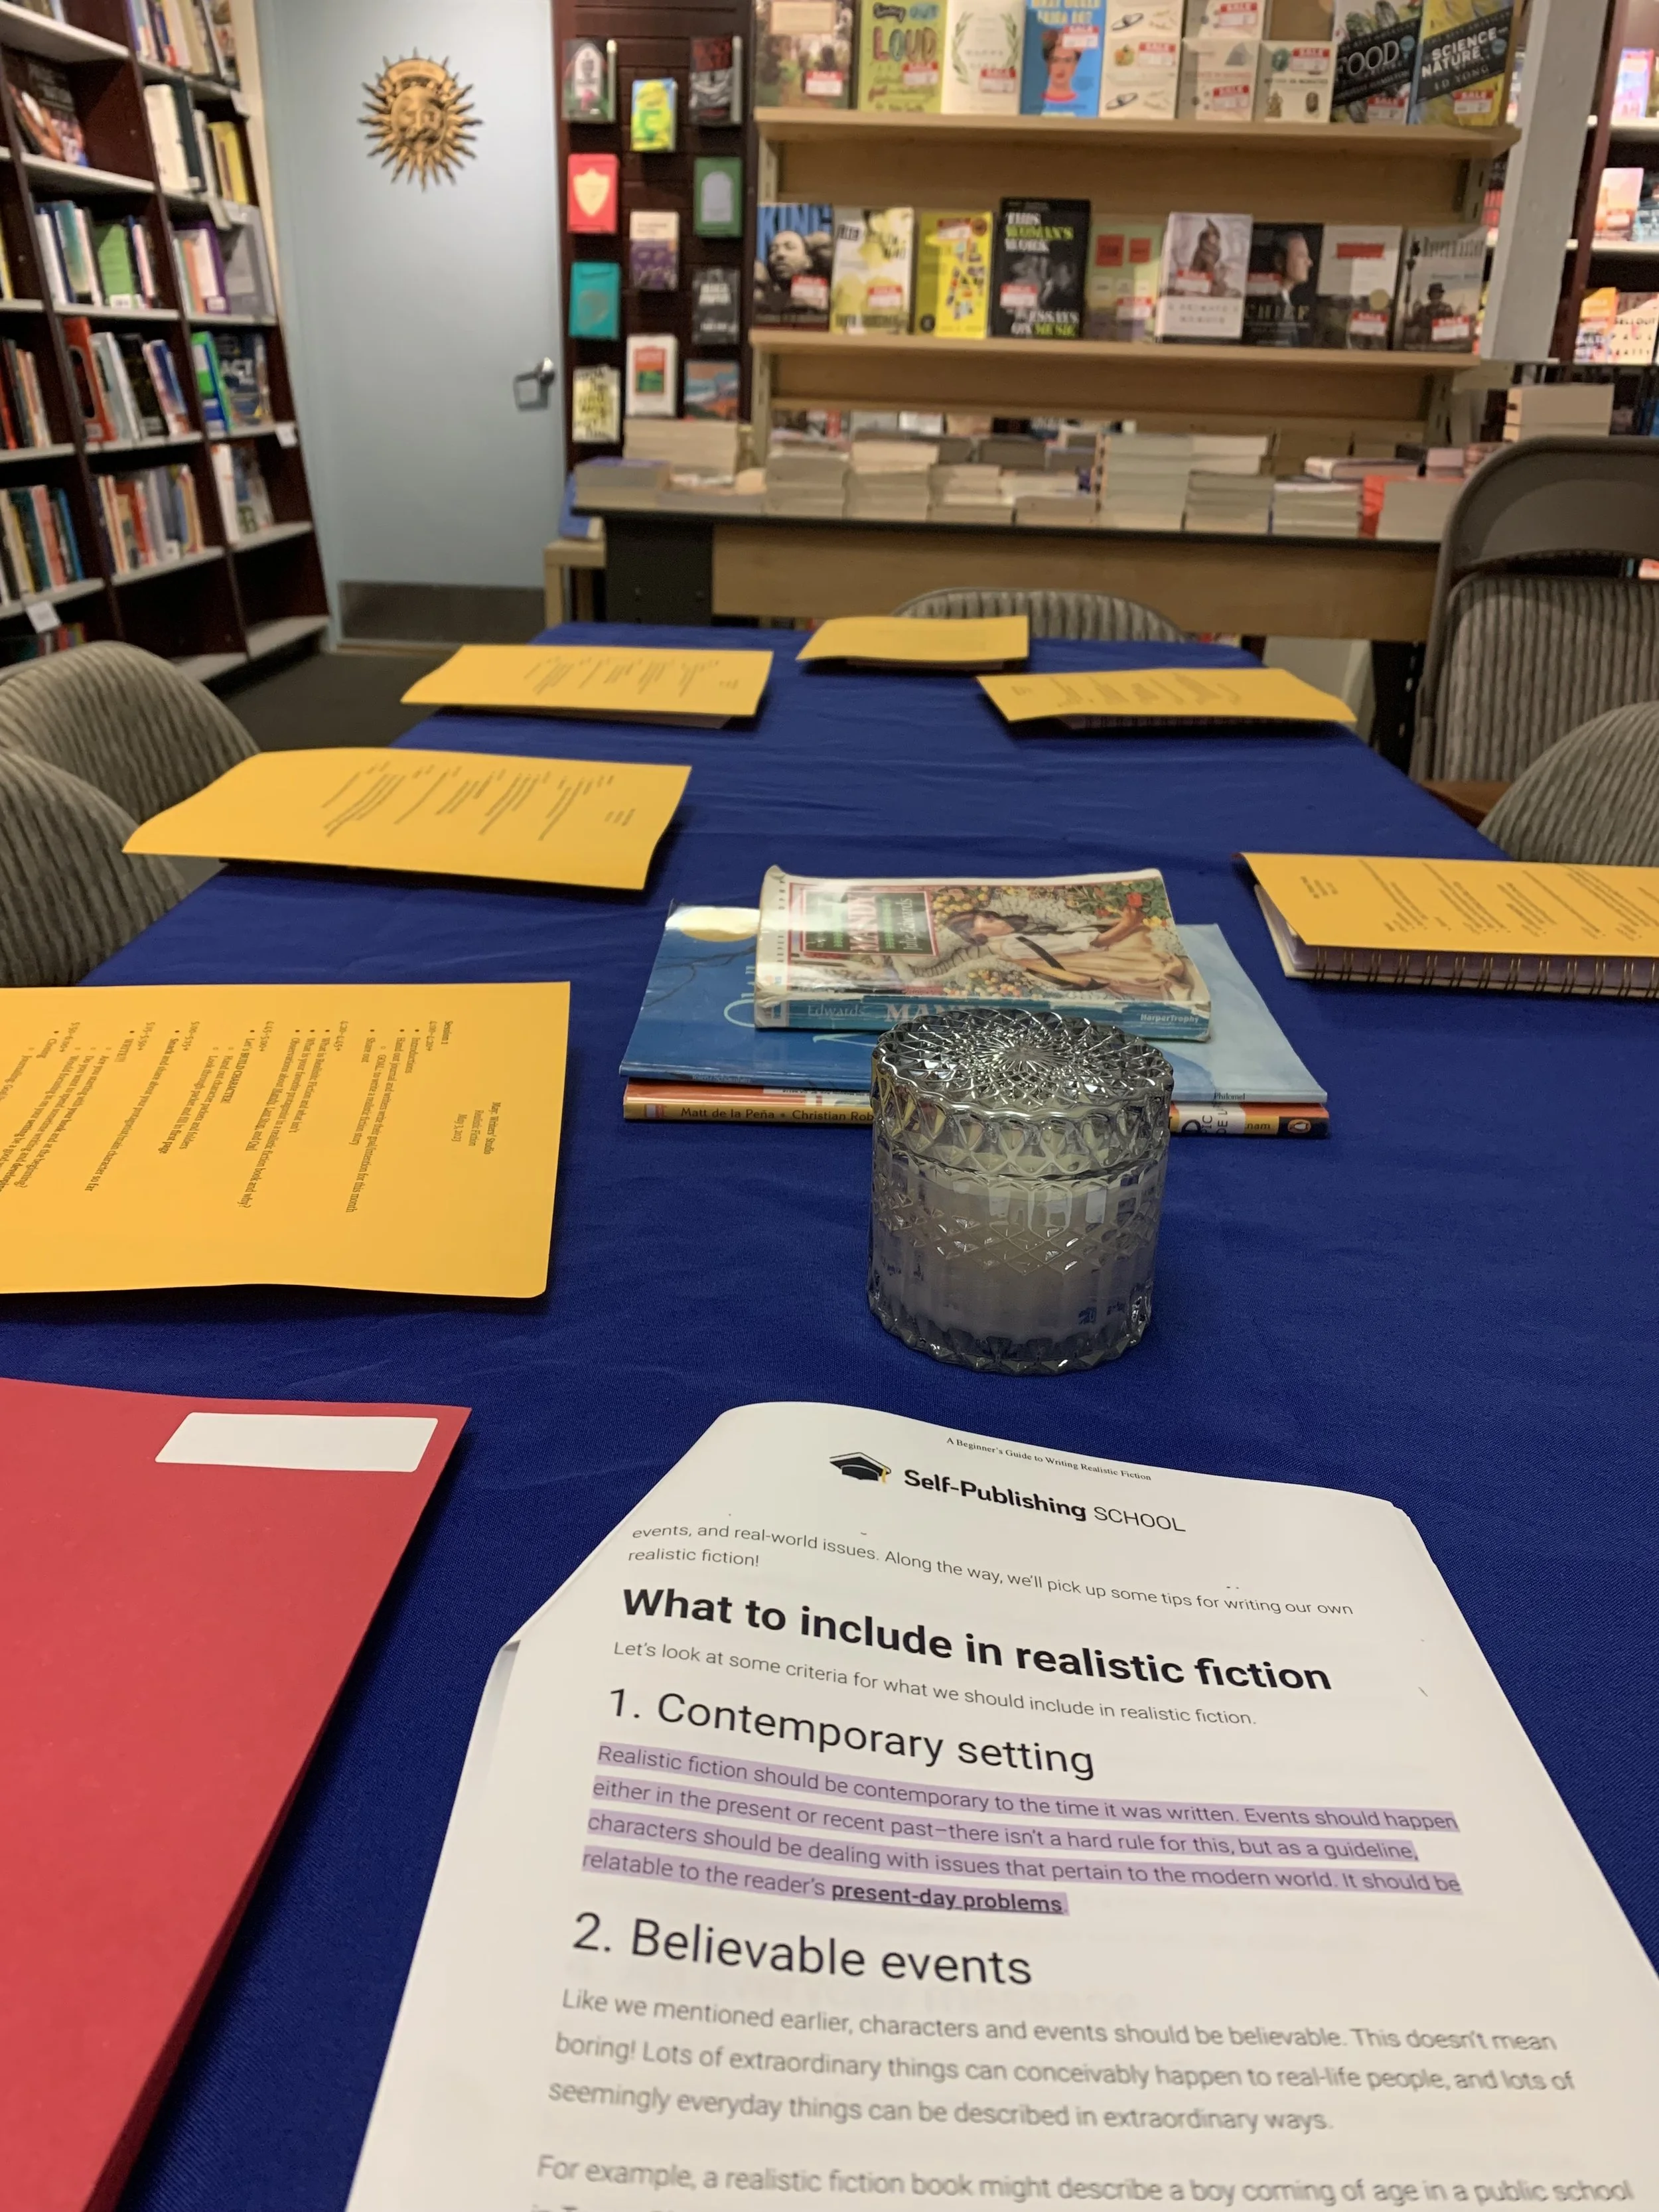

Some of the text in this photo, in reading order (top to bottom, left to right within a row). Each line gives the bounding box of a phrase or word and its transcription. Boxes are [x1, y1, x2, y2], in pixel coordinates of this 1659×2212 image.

[873, 27, 937, 63] LOUD
[1422, 45, 1481, 78] NATURE
[1432, 27, 1497, 61] SCIENCE
[900, 934, 923, 951] Julie
[808, 1003, 863, 1017] Edwards
[1140, 1013, 1199, 1023] HarperTrophy
[681, 1107, 707, 1118] Matt
[714, 1108, 726, 1118] de
[731, 1108, 741, 1119] la
[746, 1108, 775, 1120] Peña
[792, 1109, 846, 1121] Christian
[484, 1138, 495, 1155] Studio
[956, 1439, 1003, 1454] Beginner's
[1005, 1449, 1032, 1460] Guide
[1045, 1457, 1078, 1470] Writing
[1080, 1463, 1118, 1475] Realistic
[1121, 1470, 1151, 1481] Fiction
[904, 1469, 1187, 1532] Self-Publishing SCHOOL
[628, 1547, 759, 1567] realistic fiction!
[632, 1524, 1353, 1615] events, and real-world issues. Along the way, we'll pick up some tips for writing our own
[623, 1589, 1331, 1690] What to include in realistic fiction
[614, 1642, 1257, 1725] Let's look at some criteria for what we should include in realistic fiction.
[609, 1687, 1094, 1781] 1. Contemporary setting
[598, 1745, 1457, 1832] Realistic fiction should be contemporary to the time it was written. Events should happen
[593, 1781, 650, 1801] either
[656, 1787, 673, 1803] in
[680, 1790, 711, 1810] the
[717, 1797, 791, 1824] present
[797, 1808, 818, 1824] or
[823, 1810, 885, 1833] recent
[1005, 1827, 1043, 1846] isn't
[1049, 1834, 1062, 1846] a
[1067, 1832, 1112, 1850] hard
[1118, 1834, 1154, 1851] rule
[1161, 1834, 1187, 1853] for
[1193, 1836, 1235, 1855] this,
[1240, 1838, 1271, 1855] but
[1277, 1842, 1300, 1856] as
[1306, 1844, 1318, 1857] a
[1324, 1840, 1419, 1861] guideline,
[588, 1814, 1461, 1893] characters should be dealing with issues that pertain to the modern world. It should be
[582, 1850, 673, 1880] relatable
[679, 1862, 699, 1881] to
[706, 1866, 737, 1886] the
[744, 1873, 825, 1897] reader's
[831, 1882, 956, 1910] present-day
[573, 1912, 1032, 1985] 2. Believable events
